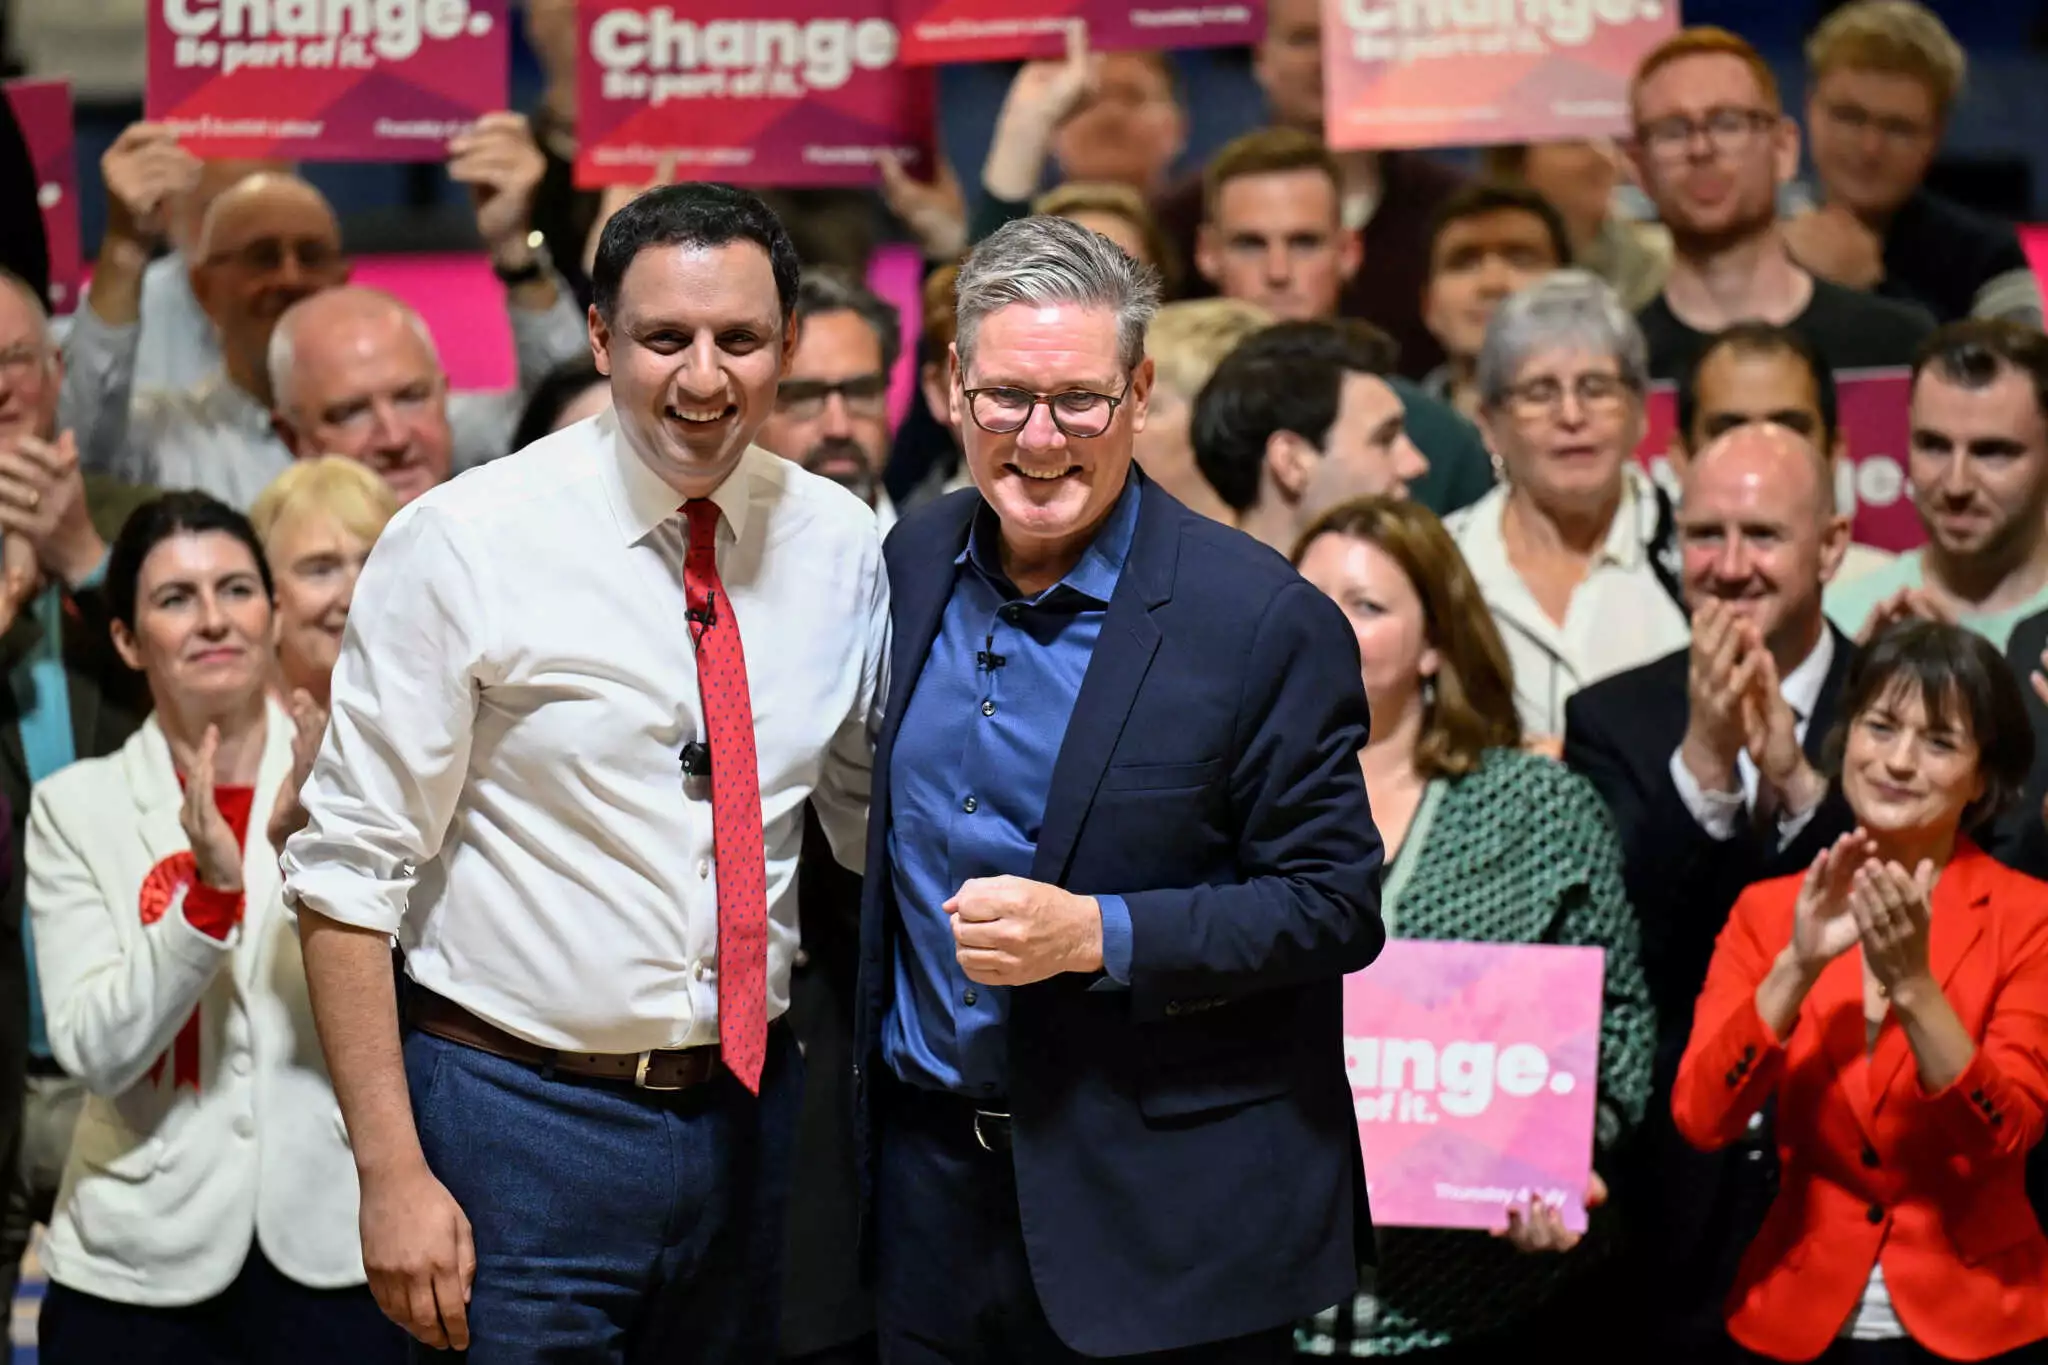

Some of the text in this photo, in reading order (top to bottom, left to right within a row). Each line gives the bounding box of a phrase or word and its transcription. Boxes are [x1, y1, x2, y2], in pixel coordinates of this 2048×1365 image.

[163, 0, 494, 61] Change.
[588, 6, 900, 90] Change
[1343, 1036, 1576, 1117] ange.
[1357, 1091, 1439, 1123] of it.
